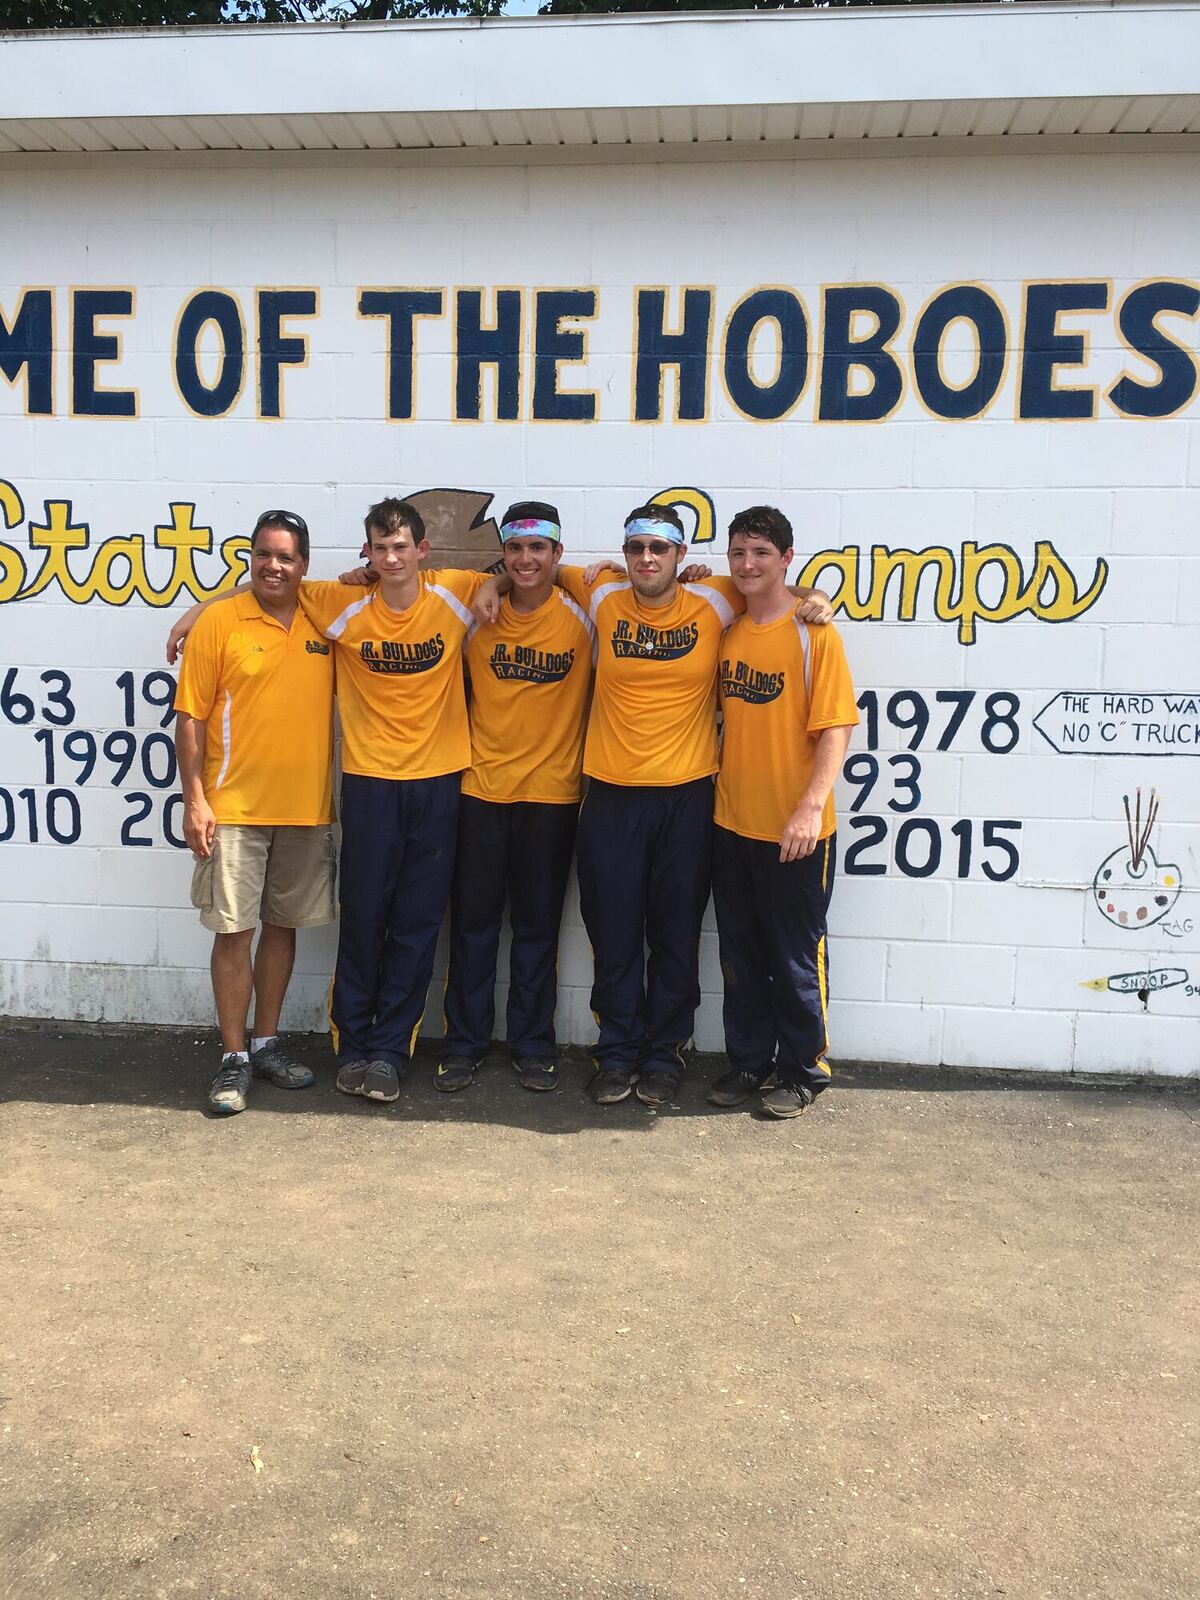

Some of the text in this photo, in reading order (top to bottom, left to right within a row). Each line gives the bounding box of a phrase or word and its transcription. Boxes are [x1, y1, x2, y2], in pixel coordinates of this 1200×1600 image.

[0, 277, 1200, 424] ME OF THE HOBOES
[359, 632, 445, 661] JR. BULLDOGS
[612, 620, 698, 649] JR. BULLDOGS
[490, 644, 575, 672] JR. BULLDOGS
[0, 667, 76, 725] 63
[856, 690, 1020, 754] 1978
[1062, 696, 1200, 714] THE HARD WA
[1062, 722, 1090, 743] NO
[34, 729, 922, 812] 1990 93
[844, 815, 1022, 882] 2015
[1120, 973, 1169, 989] SNOOP
